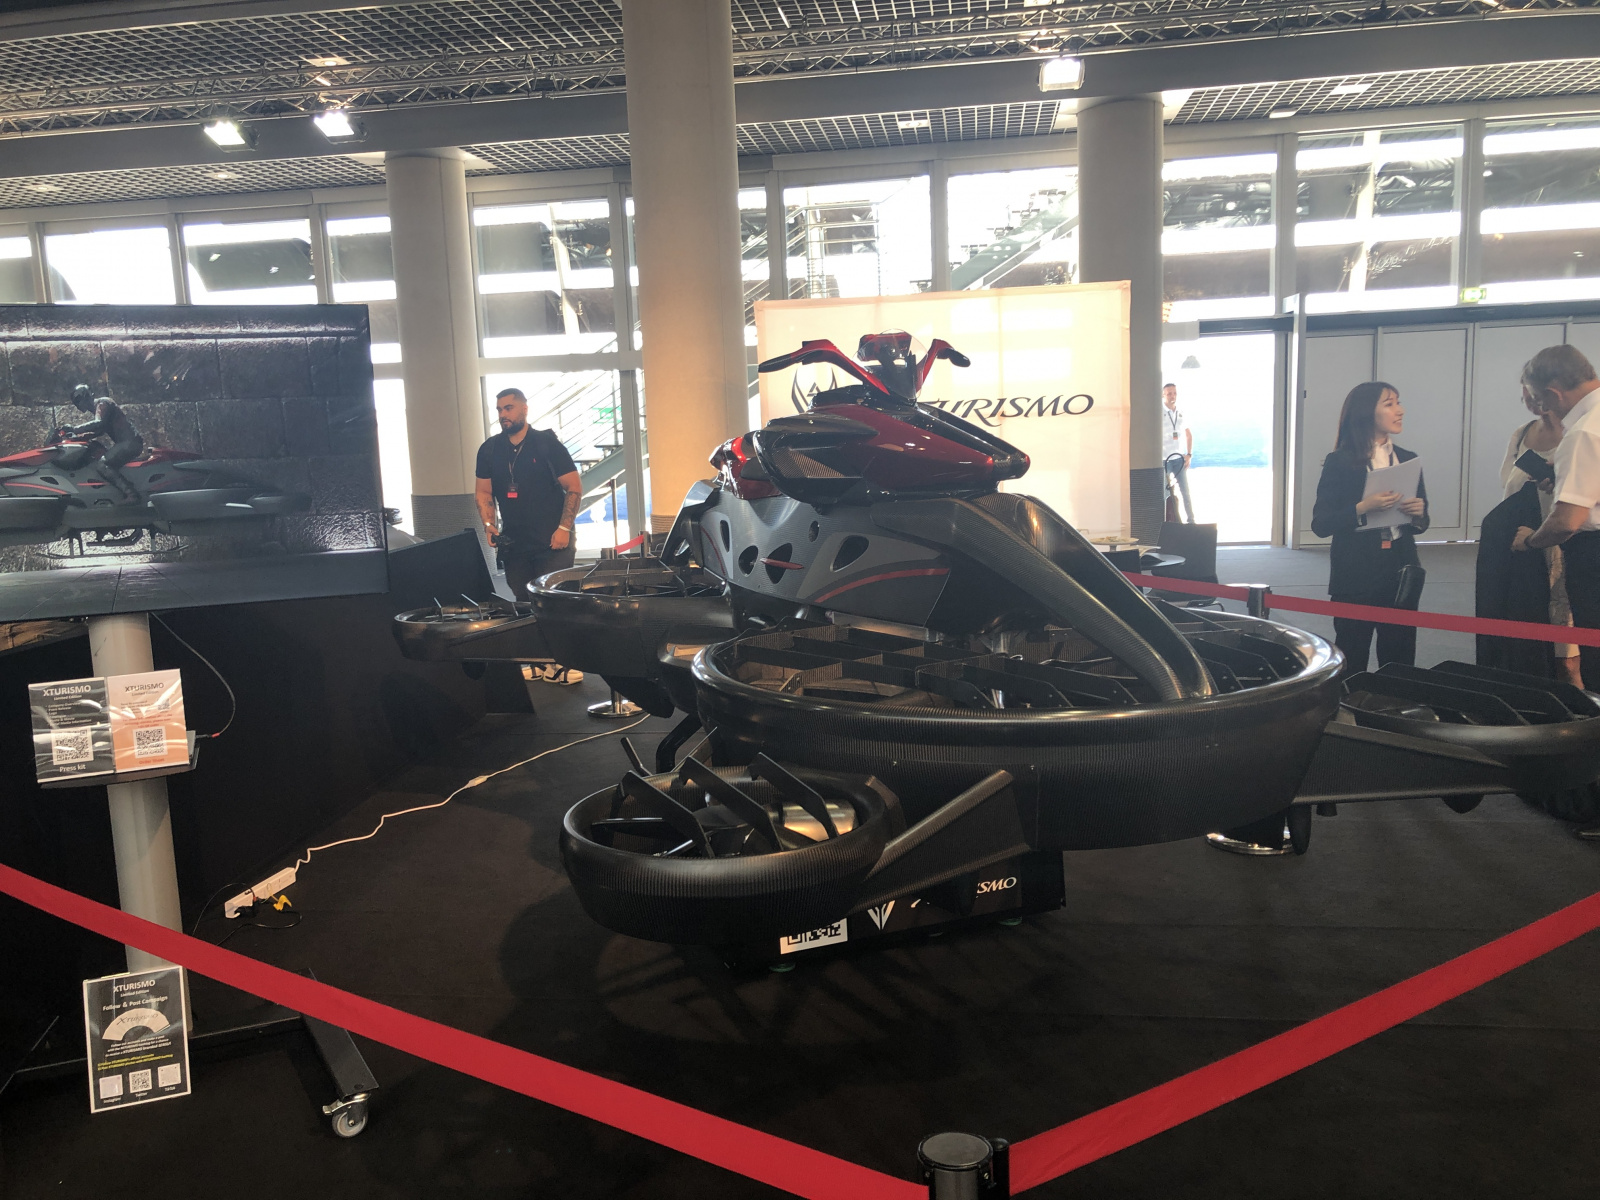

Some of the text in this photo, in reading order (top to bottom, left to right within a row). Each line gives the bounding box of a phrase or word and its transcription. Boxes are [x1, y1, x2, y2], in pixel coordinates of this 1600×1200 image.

[43, 685, 92, 697] XTURISMO
[125, 682, 165, 692] XTURISMO
[59, 765, 77, 773] Press
[976, 876, 1017, 894] SMO
[113, 979, 156, 993] XTURISMO
[142, 995, 168, 1004] Campaign
